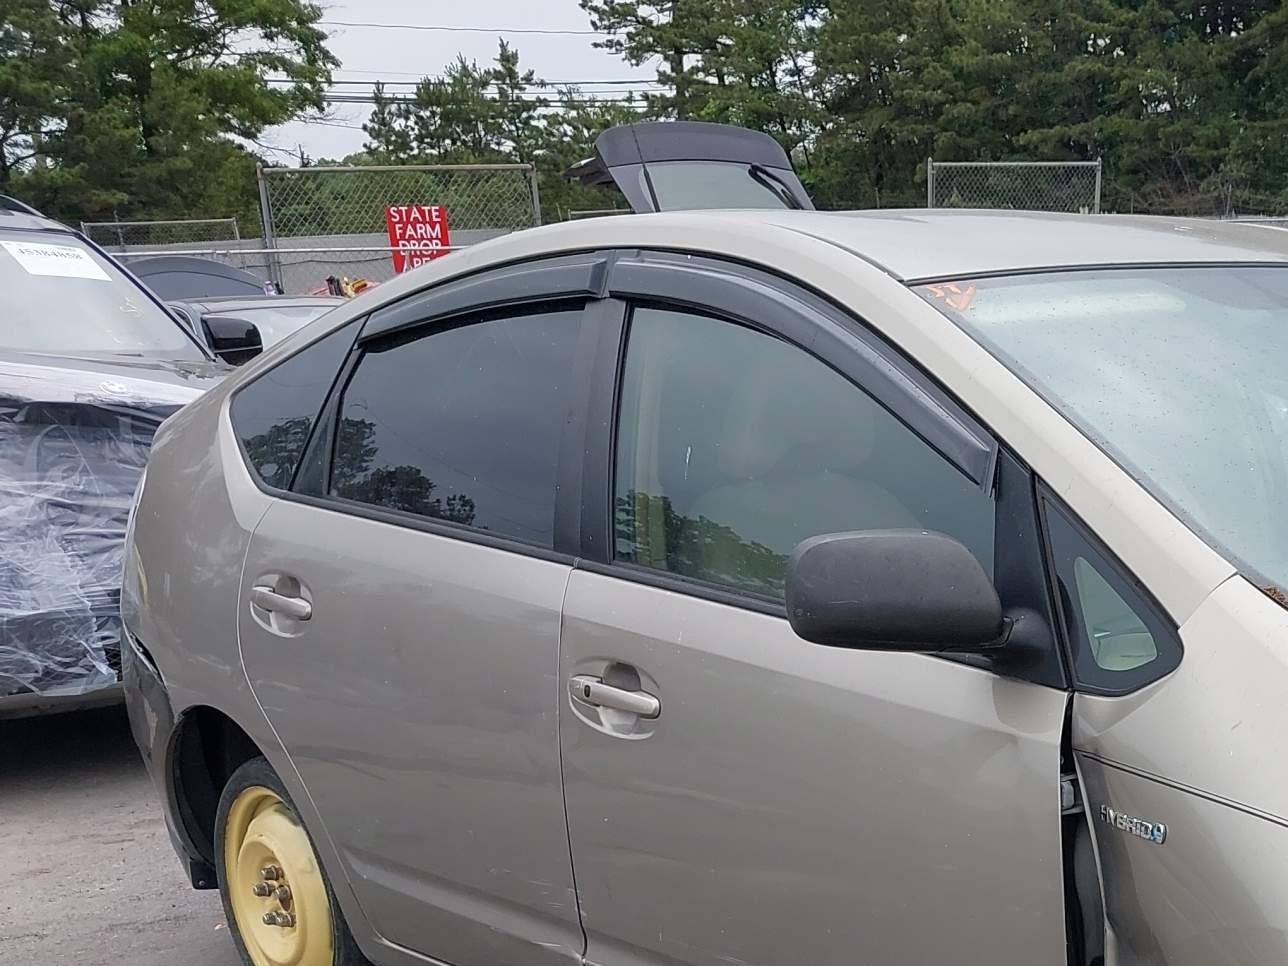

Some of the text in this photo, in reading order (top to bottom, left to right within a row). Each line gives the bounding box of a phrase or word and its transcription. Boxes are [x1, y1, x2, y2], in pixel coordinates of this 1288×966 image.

[390, 206, 442, 222] STATE
[395, 223, 442, 239] FARM
[399, 239, 442, 256] DROP
[1100, 804, 1154, 841] HYBRID
